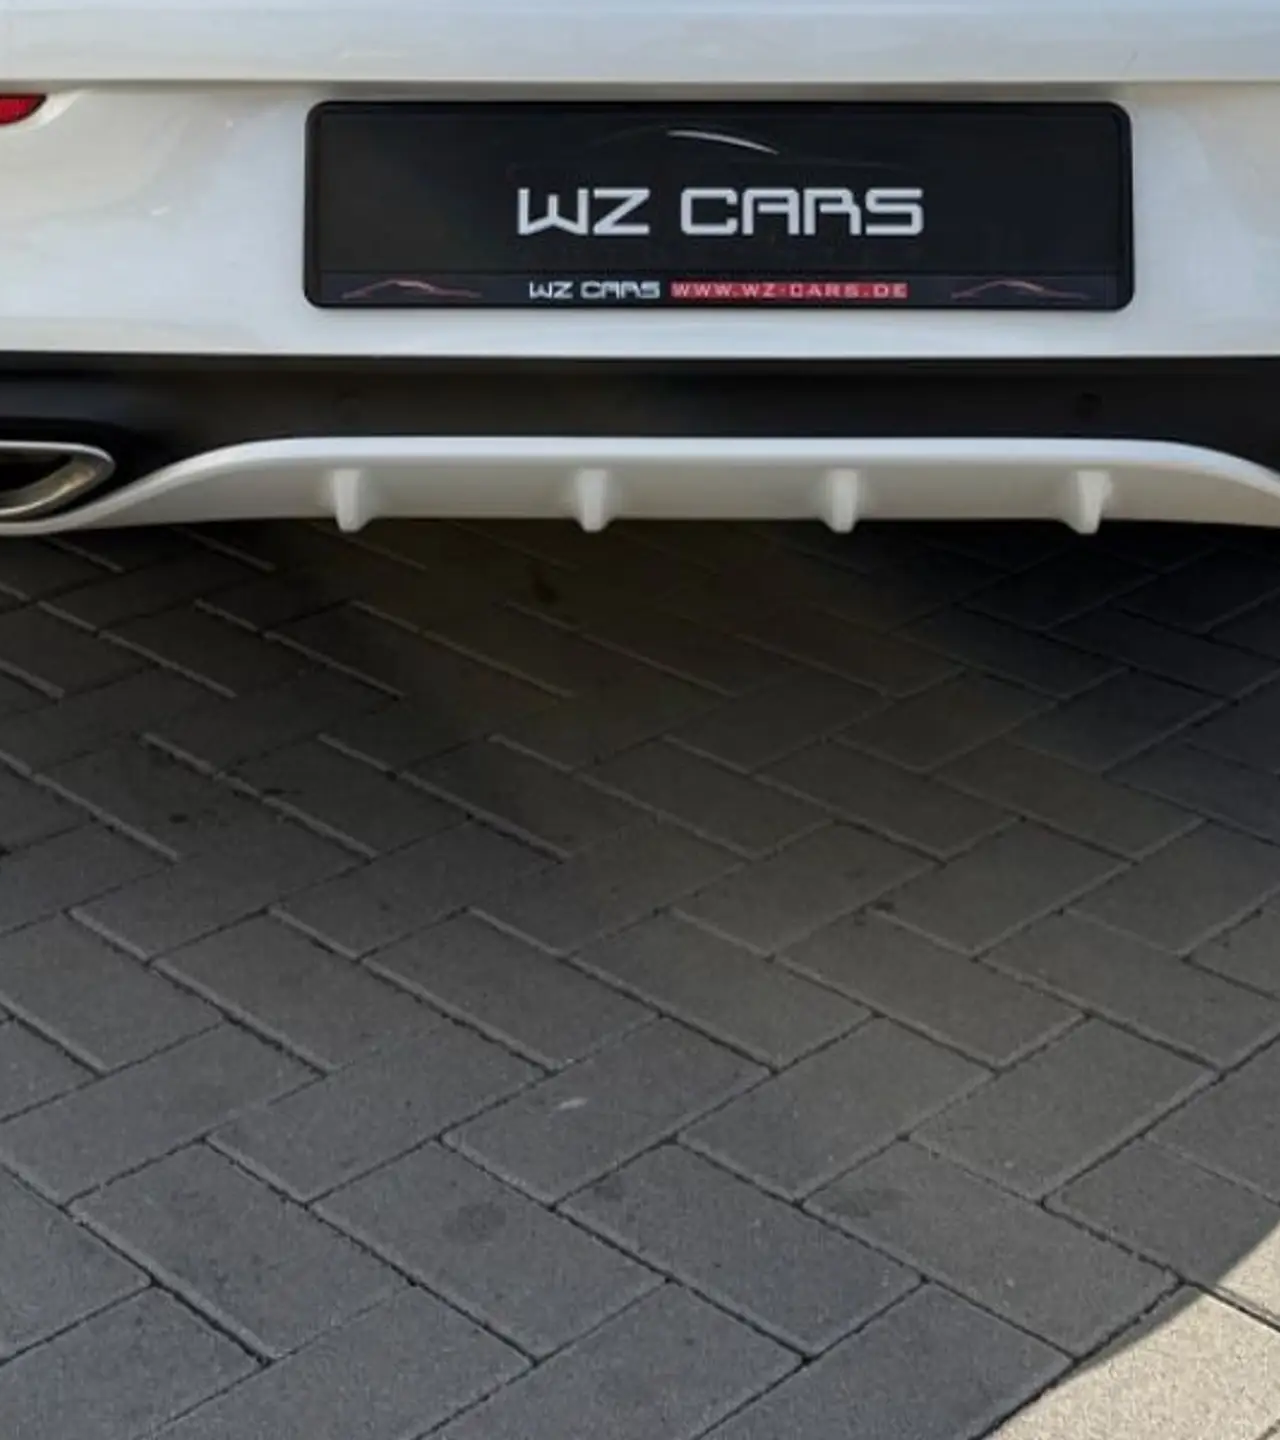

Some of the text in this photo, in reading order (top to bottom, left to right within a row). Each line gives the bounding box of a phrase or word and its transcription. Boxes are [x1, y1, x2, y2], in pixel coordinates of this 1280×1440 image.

[517, 187, 924, 236] WZ CARS
[528, 280, 909, 300] WZ CARS WWW.WZ-CARS.DE
